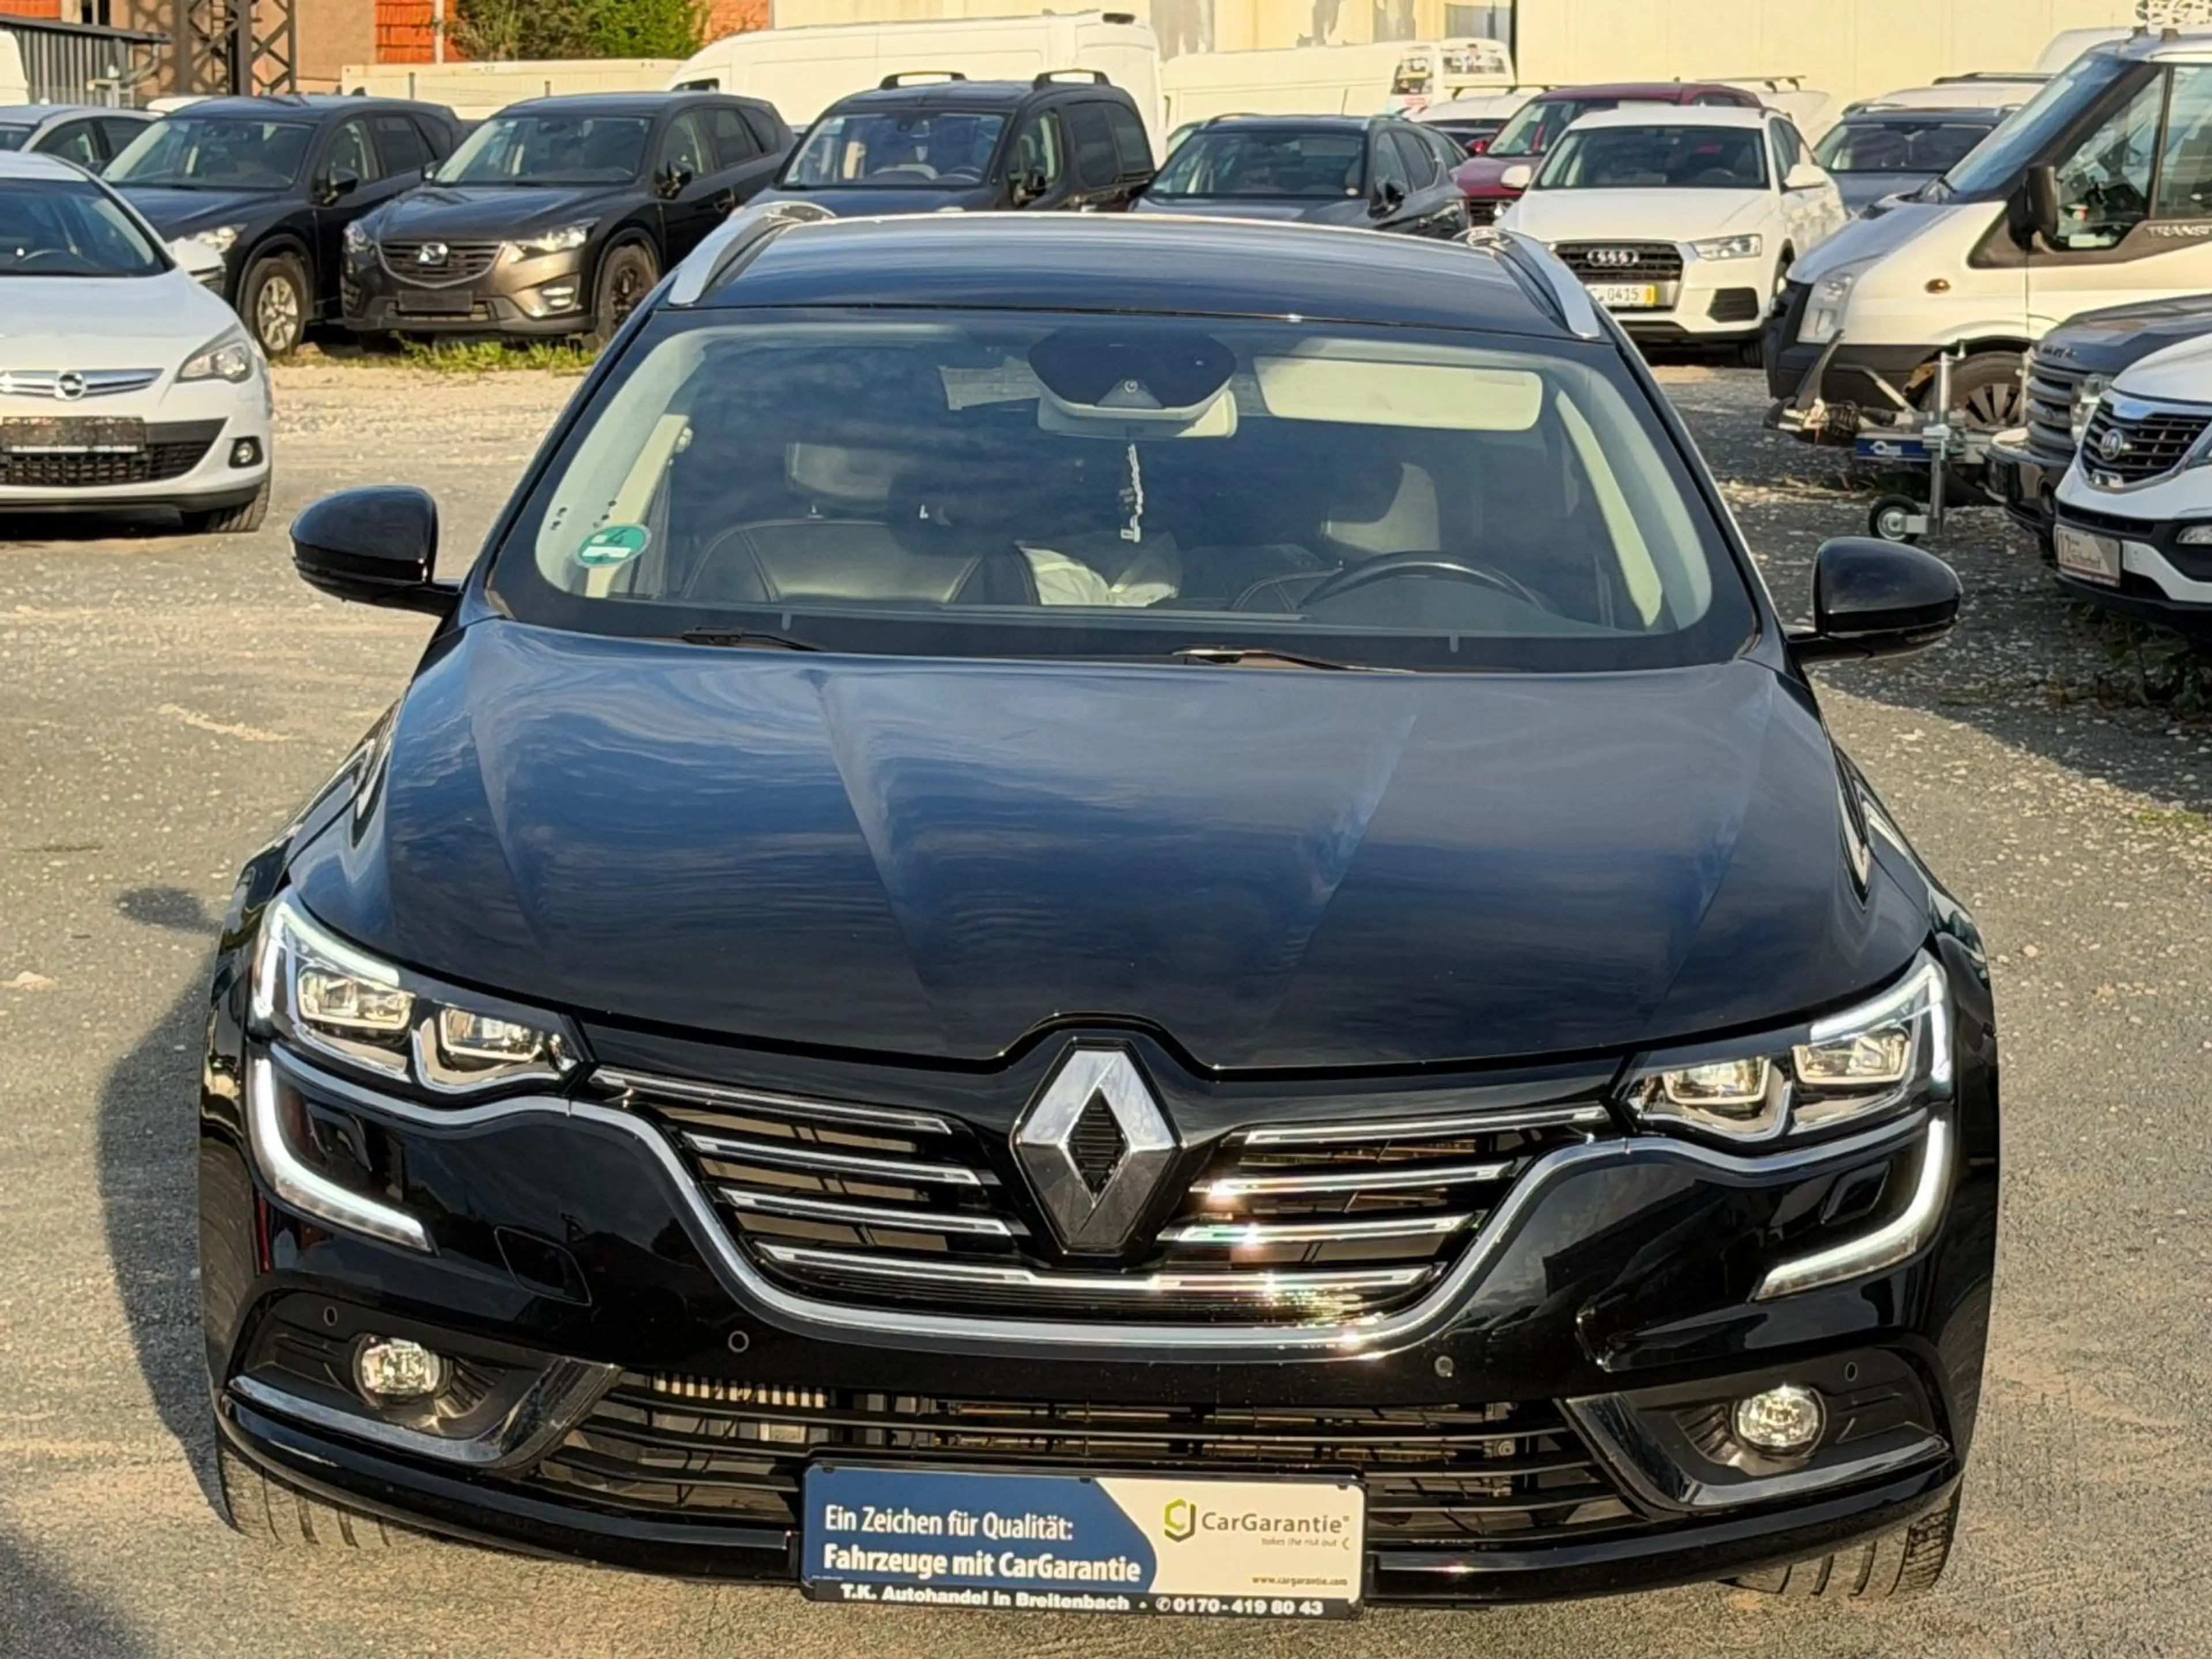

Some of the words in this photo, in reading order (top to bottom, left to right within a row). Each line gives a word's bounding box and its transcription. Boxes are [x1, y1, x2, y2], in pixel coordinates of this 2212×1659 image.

[825, 1504, 857, 1531] Ein
[861, 1506, 942, 1535] Zeichen
[948, 1509, 979, 1537] für
[982, 1512, 1073, 1541] Qualität:
[824, 1543, 948, 1580] Fahrzeuge
[952, 1550, 995, 1577] mit
[998, 1551, 1142, 1582] CarGarantie
[840, 1584, 877, 1600] T.K.
[881, 1585, 988, 1605] Autohandel
[993, 1590, 1011, 1607] in
[1015, 1591, 1130, 1611] Breitenbach
[1298, 1600, 1324, 1615] 43
